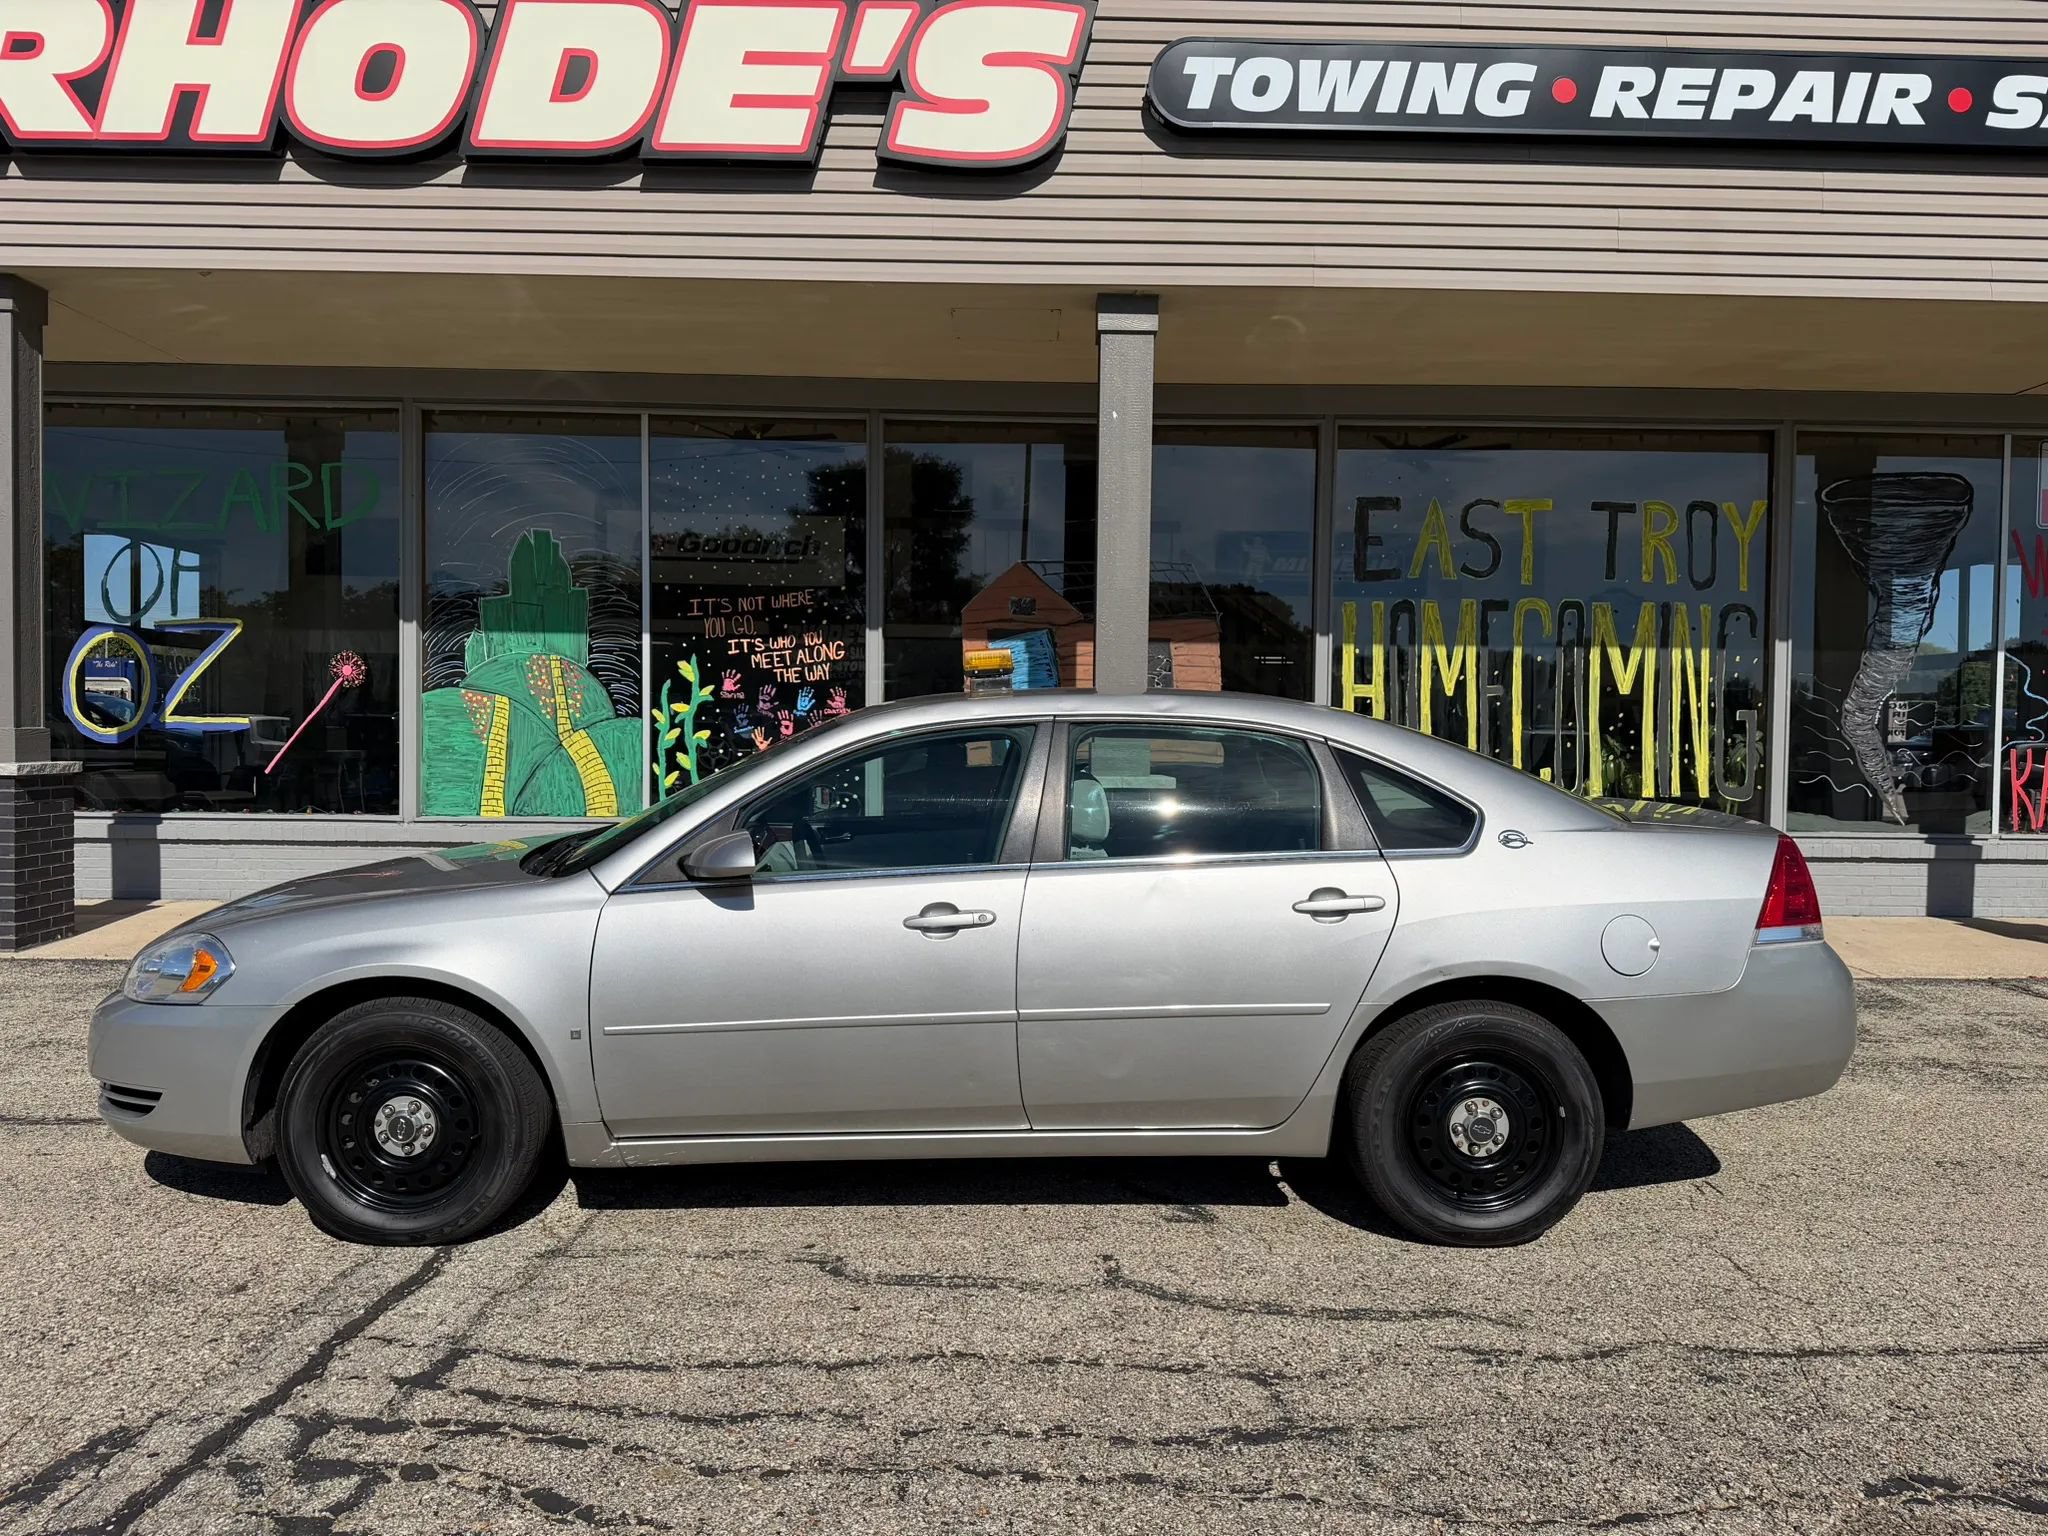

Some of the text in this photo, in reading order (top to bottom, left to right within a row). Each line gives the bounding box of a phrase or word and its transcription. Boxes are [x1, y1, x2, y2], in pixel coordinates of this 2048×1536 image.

[0, 0, 1087, 162] RHODE'S
[1182, 55, 2048, 131] TOWING REPAIR S
[1353, 496, 1768, 592] EAST TROY
[687, 589, 815, 616] IT'S NOT WHERE
[704, 616, 726, 639] YOU
[727, 630, 824, 655] IT'S WHO YOU
[751, 640, 846, 669] MEET ALONG
[62, 617, 250, 744] OZ
[773, 662, 832, 683] THE WAY
[1342, 598, 1759, 802] HOMECOMING
